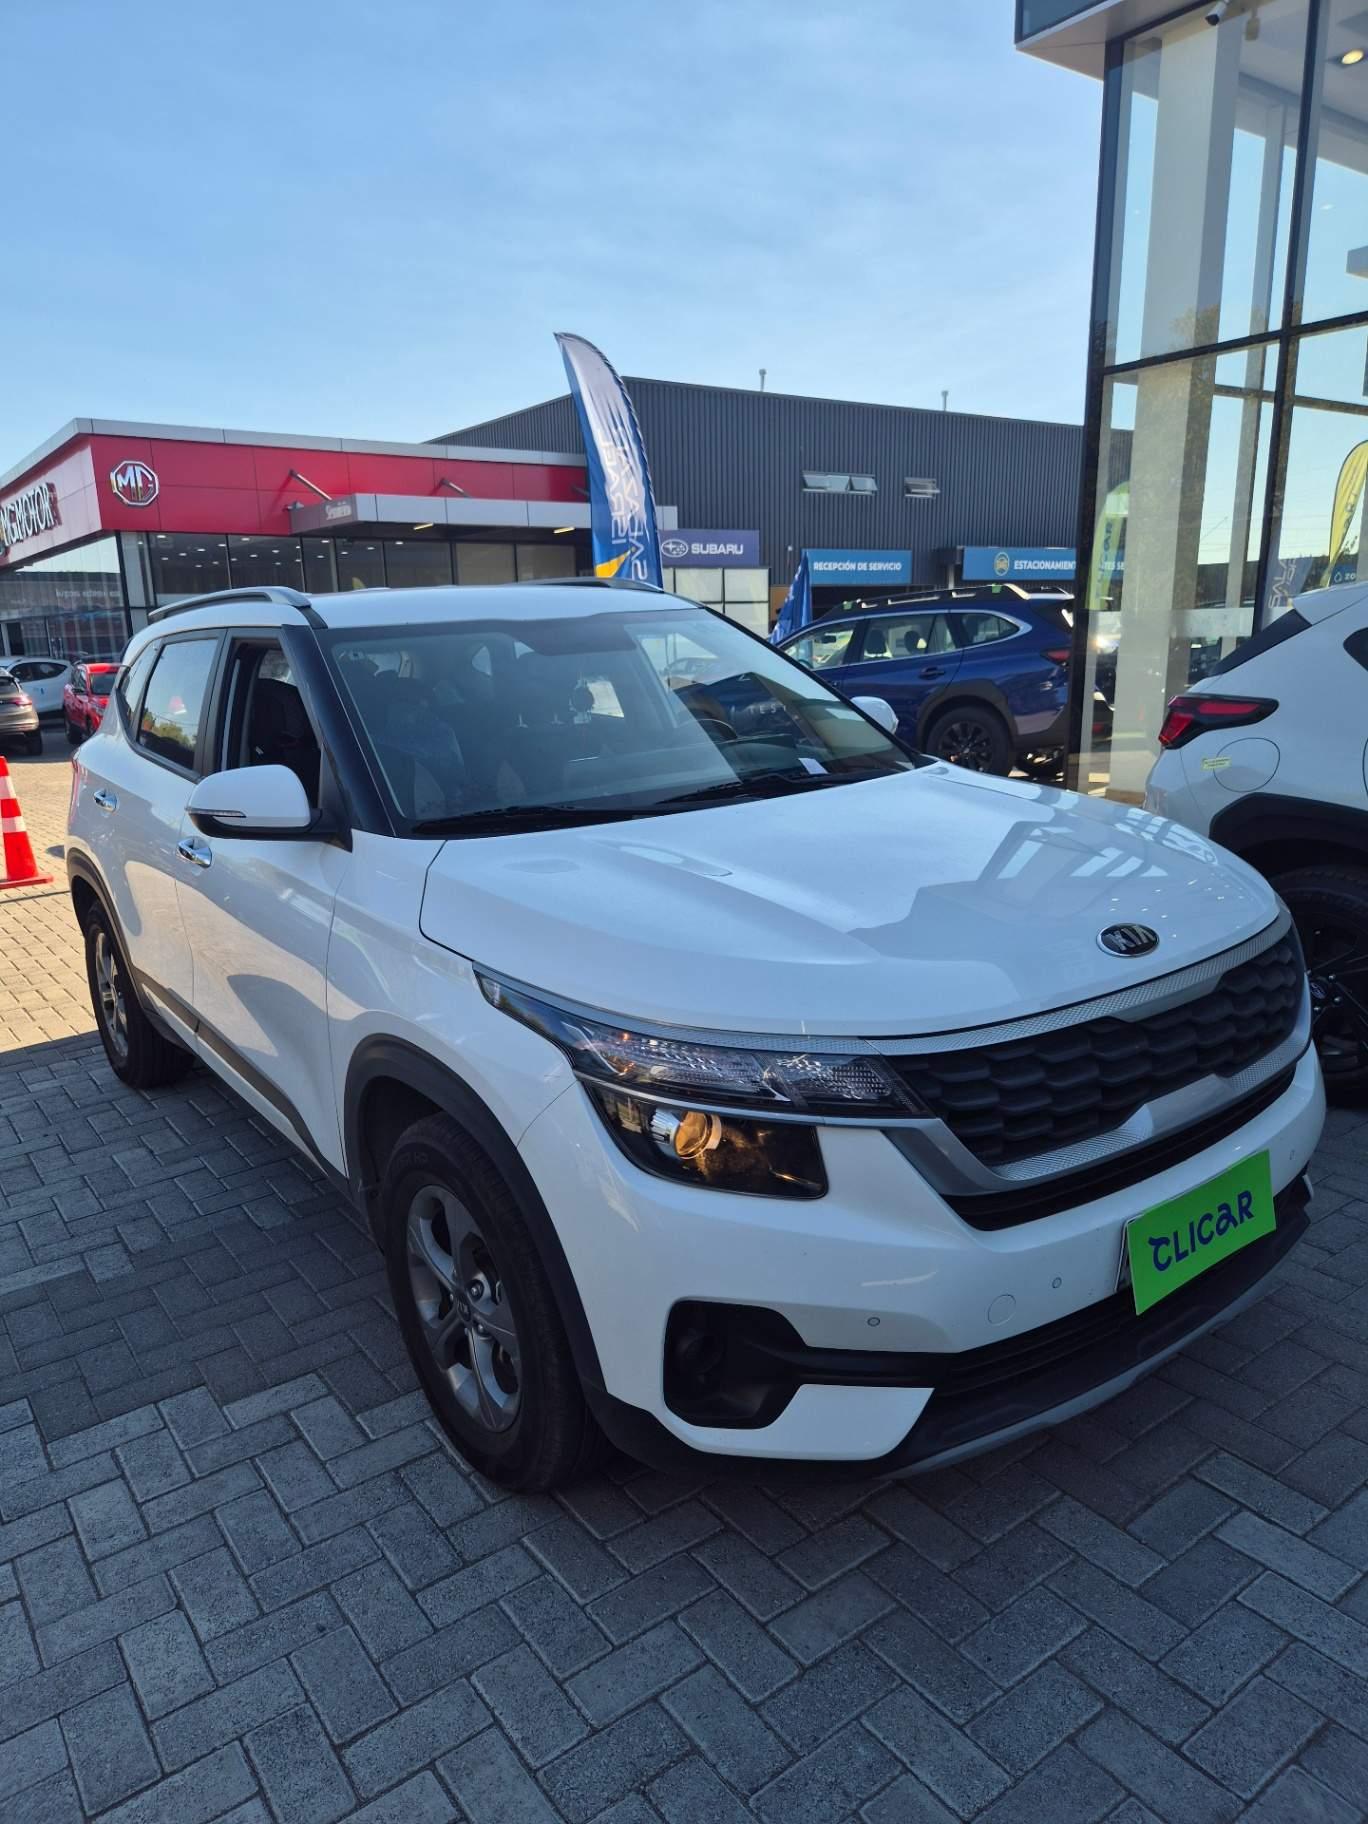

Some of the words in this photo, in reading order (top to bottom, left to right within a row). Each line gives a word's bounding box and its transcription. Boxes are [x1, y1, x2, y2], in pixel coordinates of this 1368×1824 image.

[117, 465, 154, 501] MG
[691, 543, 744, 555] SUBARU
[813, 560, 857, 571] RECEPCIÓN
[857, 562, 868, 571] DE
[868, 562, 902, 571] SERVICIO
[1013, 560, 1077, 570] ESTACIONAMIENT
[1105, 925, 1156, 951] KIA
